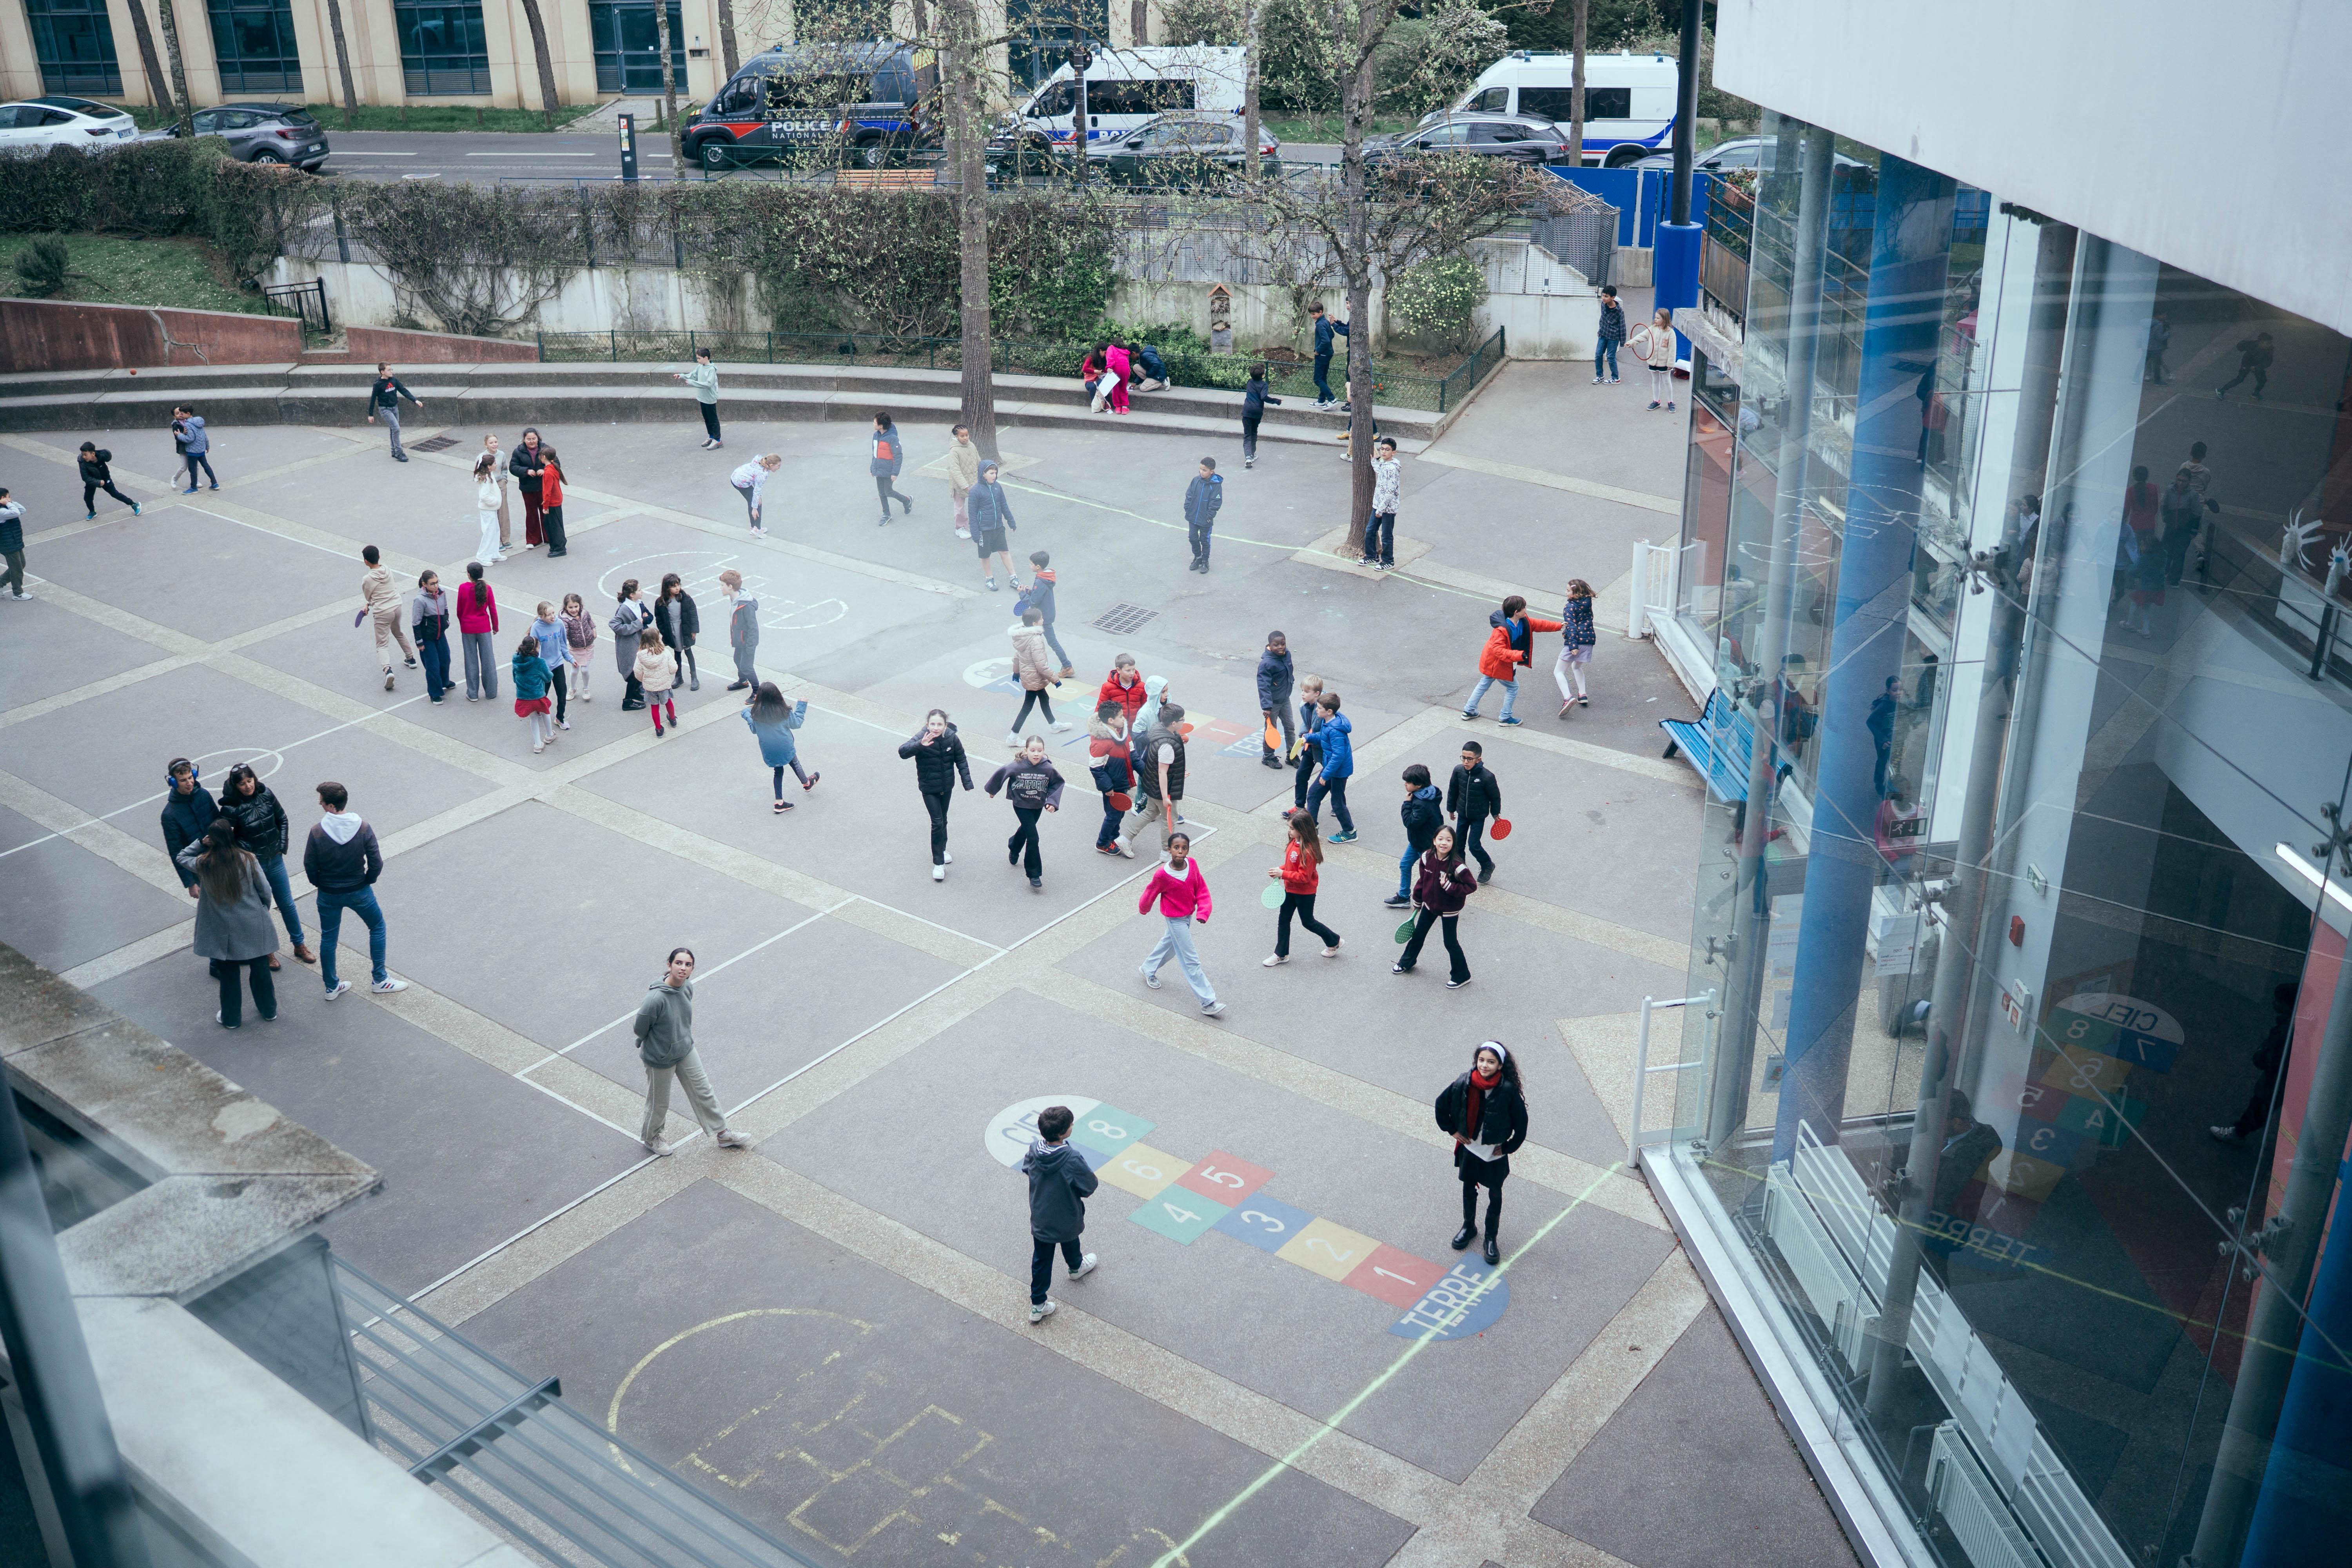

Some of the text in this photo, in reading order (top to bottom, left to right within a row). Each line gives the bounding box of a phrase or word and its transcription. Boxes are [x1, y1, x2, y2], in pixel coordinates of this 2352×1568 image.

[620, 119, 627, 129] P
[771, 121, 831, 132] POLICE
[998, 681, 1021, 691] 7
[1210, 727, 1236, 735] 1
[1001, 1110, 1041, 1145] CIE
[1088, 1120, 1127, 1139] 8
[1123, 1160, 1163, 1180] 6
[1200, 1165, 1245, 1188] 5
[1163, 1202, 1201, 1223] 4
[1241, 1210, 1285, 1232] 3
[1305, 1238, 1354, 1261] 2
[1373, 1266, 1416, 1285] 1
[1400, 1263, 1502, 1336] TERRE
